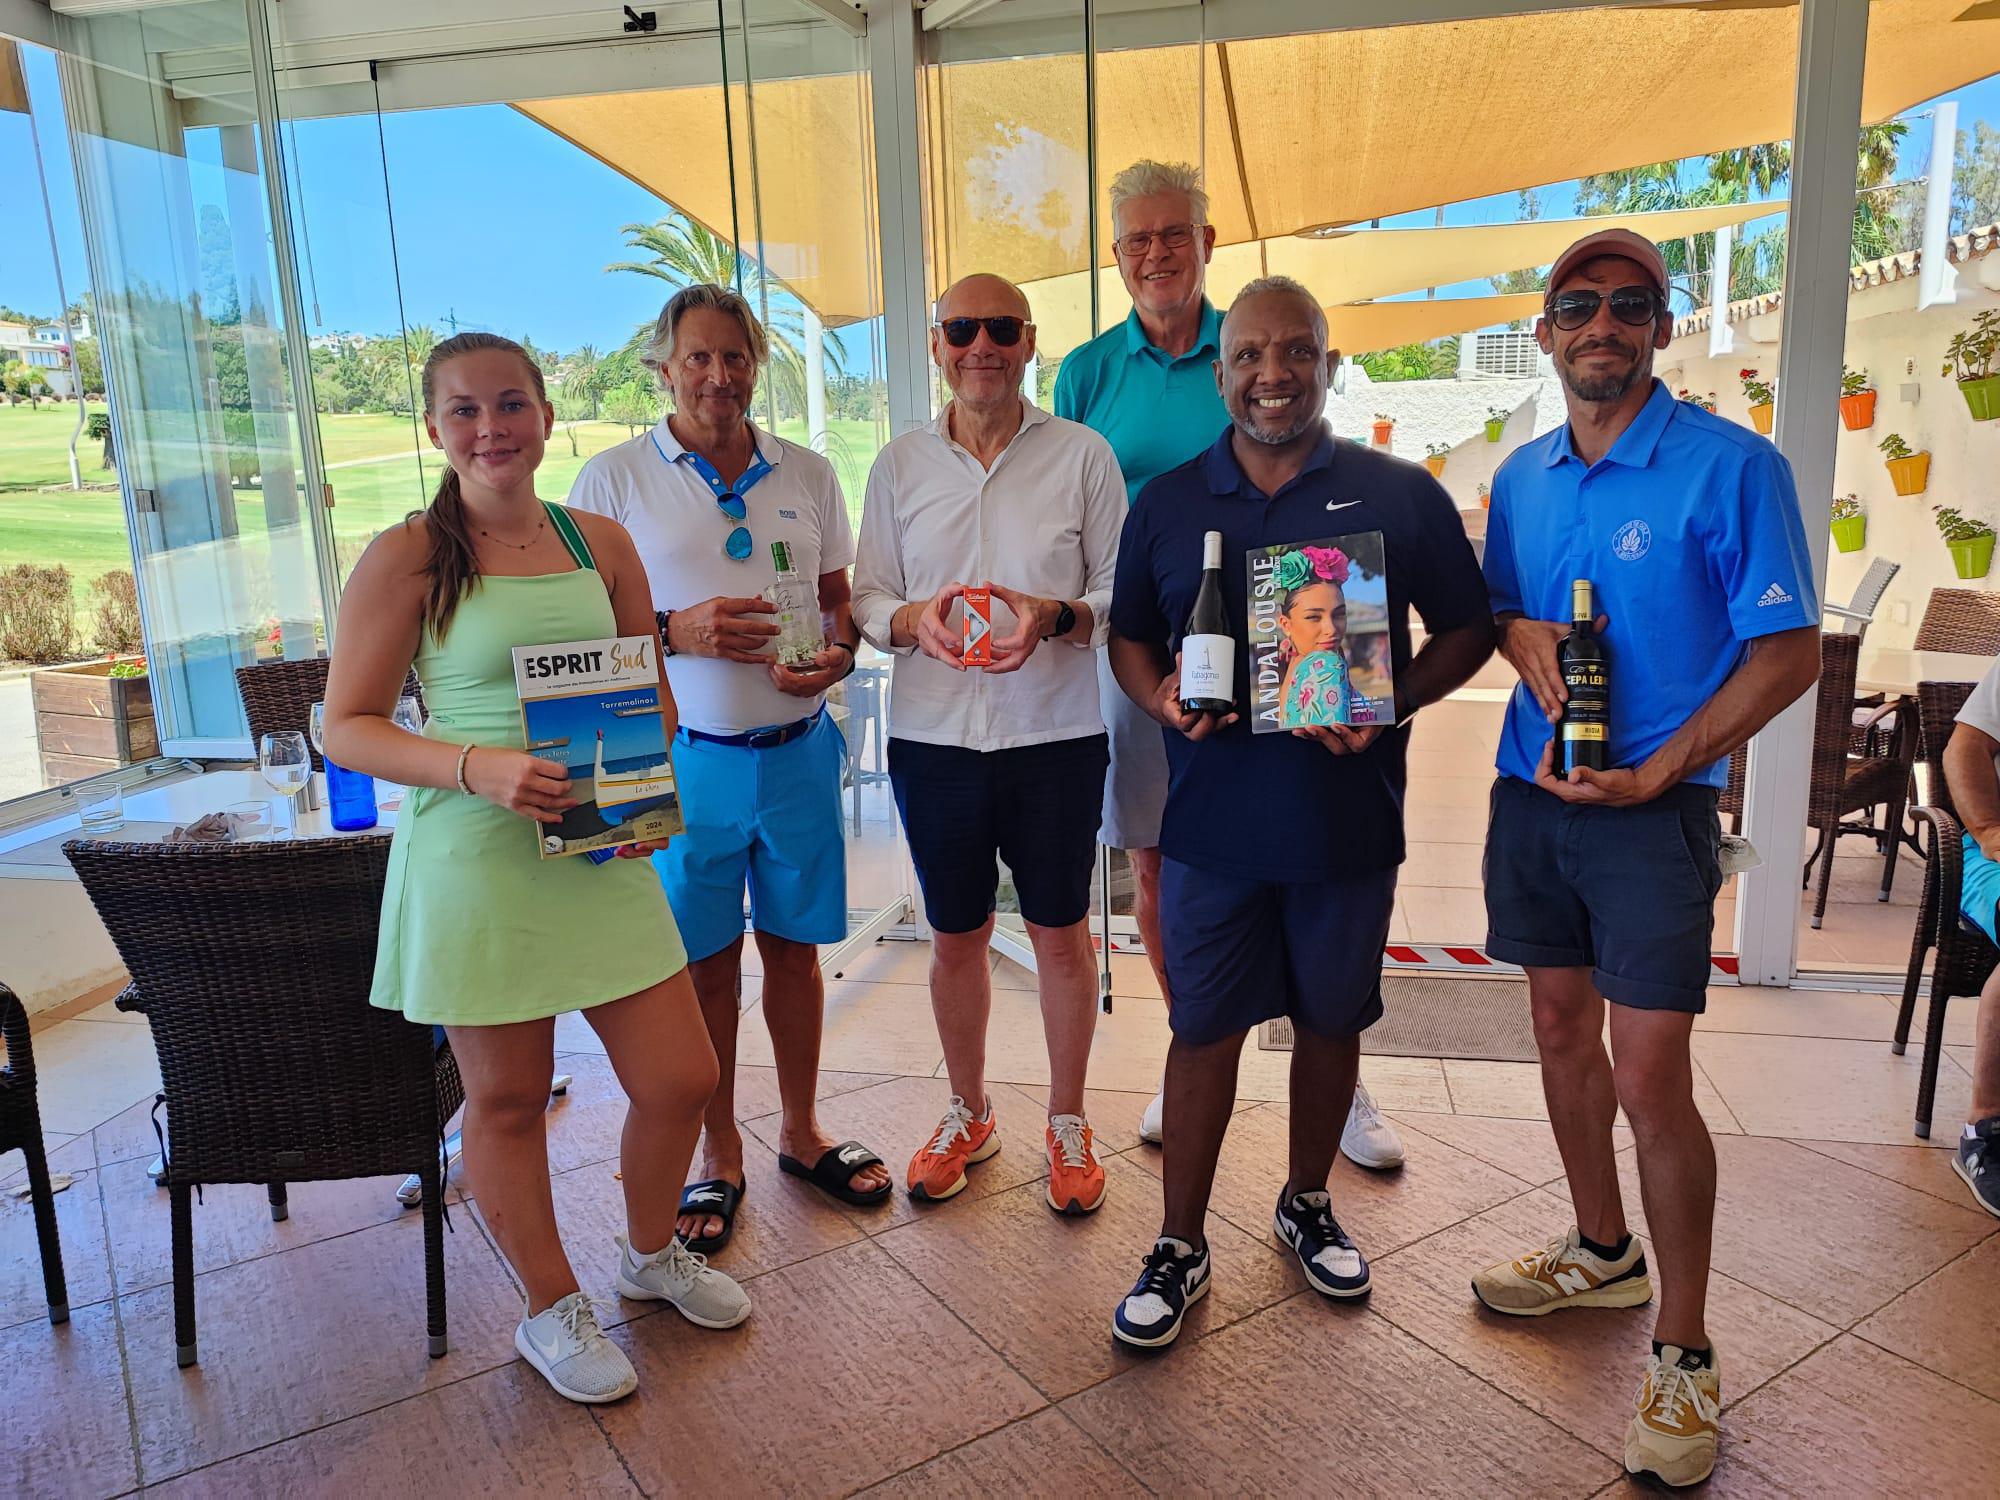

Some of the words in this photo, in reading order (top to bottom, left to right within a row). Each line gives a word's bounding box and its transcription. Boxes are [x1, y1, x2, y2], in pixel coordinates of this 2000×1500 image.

[1757, 594, 1793, 607] adidas
[1253, 556, 1280, 722] ANDALOUSIE
[526, 651, 602, 678] ESPRIT
[610, 642, 647, 675] Sud
[601, 698, 654, 709] Torremolinos
[645, 821, 663, 830] 2024
